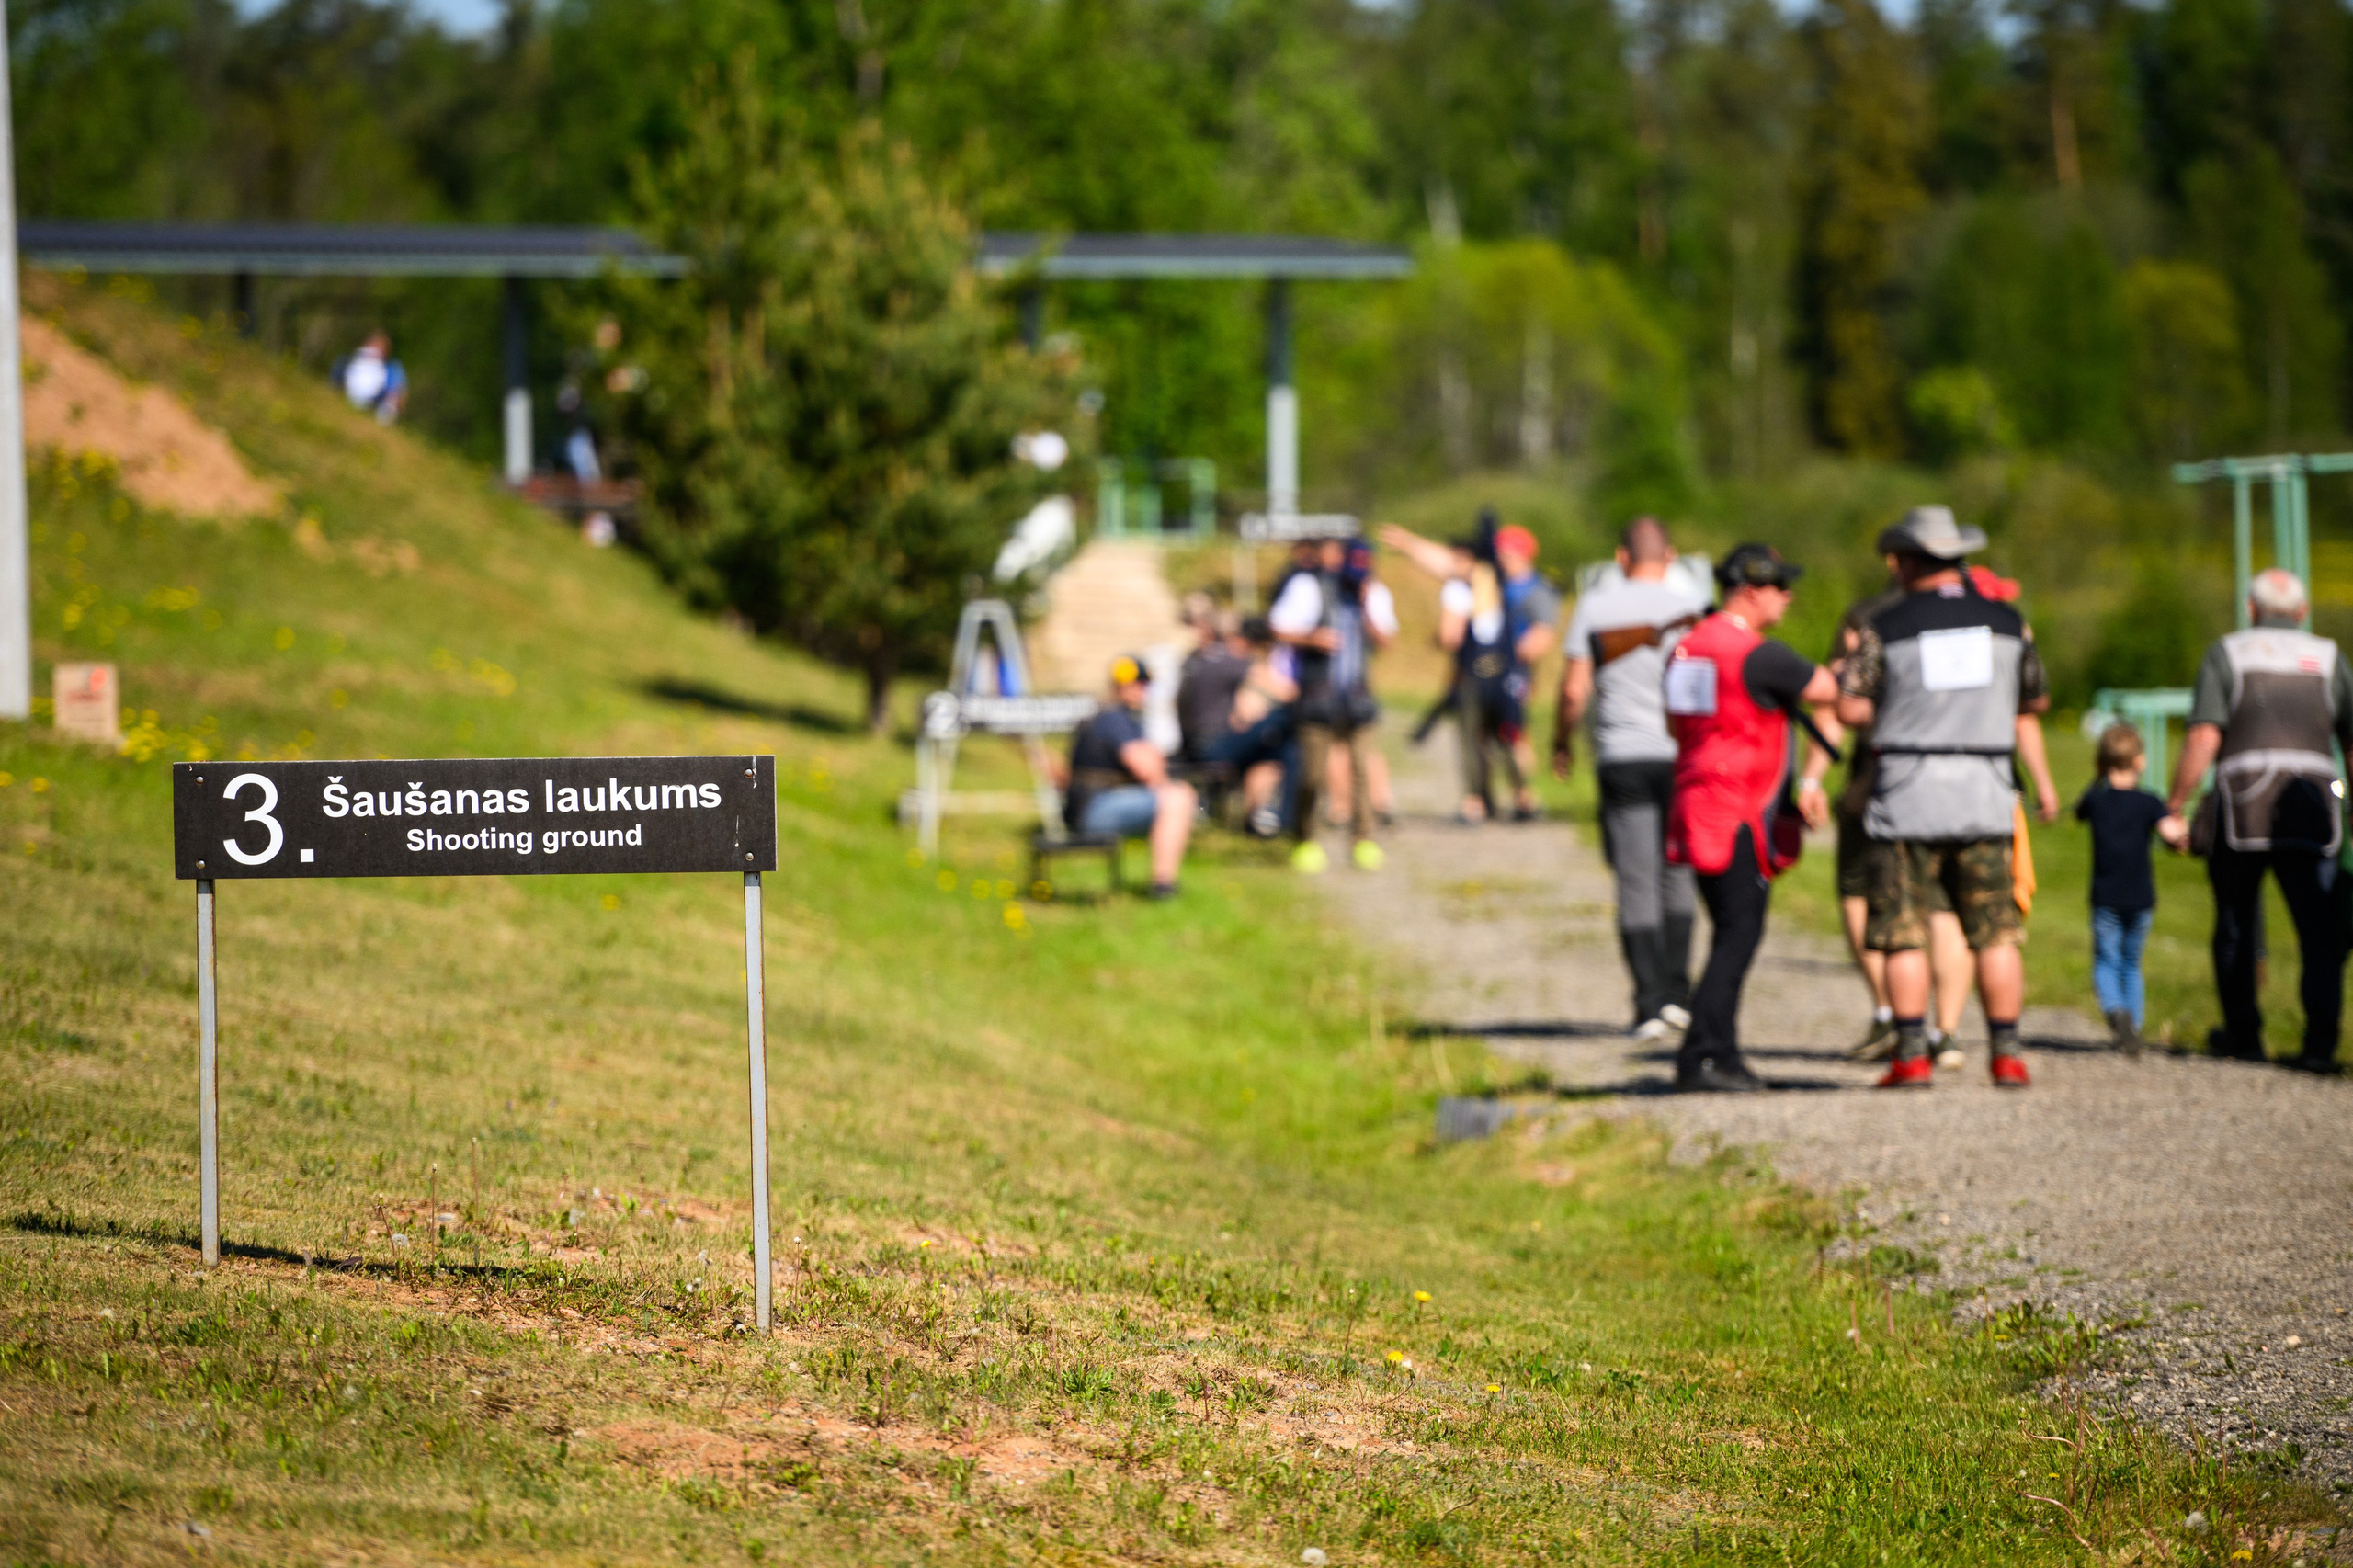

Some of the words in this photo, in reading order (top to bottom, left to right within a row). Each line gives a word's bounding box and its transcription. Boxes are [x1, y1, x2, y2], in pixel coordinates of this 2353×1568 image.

[322, 775, 530, 818] Šaušanas
[545, 778, 722, 812] laukums
[222, 772, 314, 866] 3.
[406, 827, 534, 854] Shooting
[542, 824, 642, 854] ground
